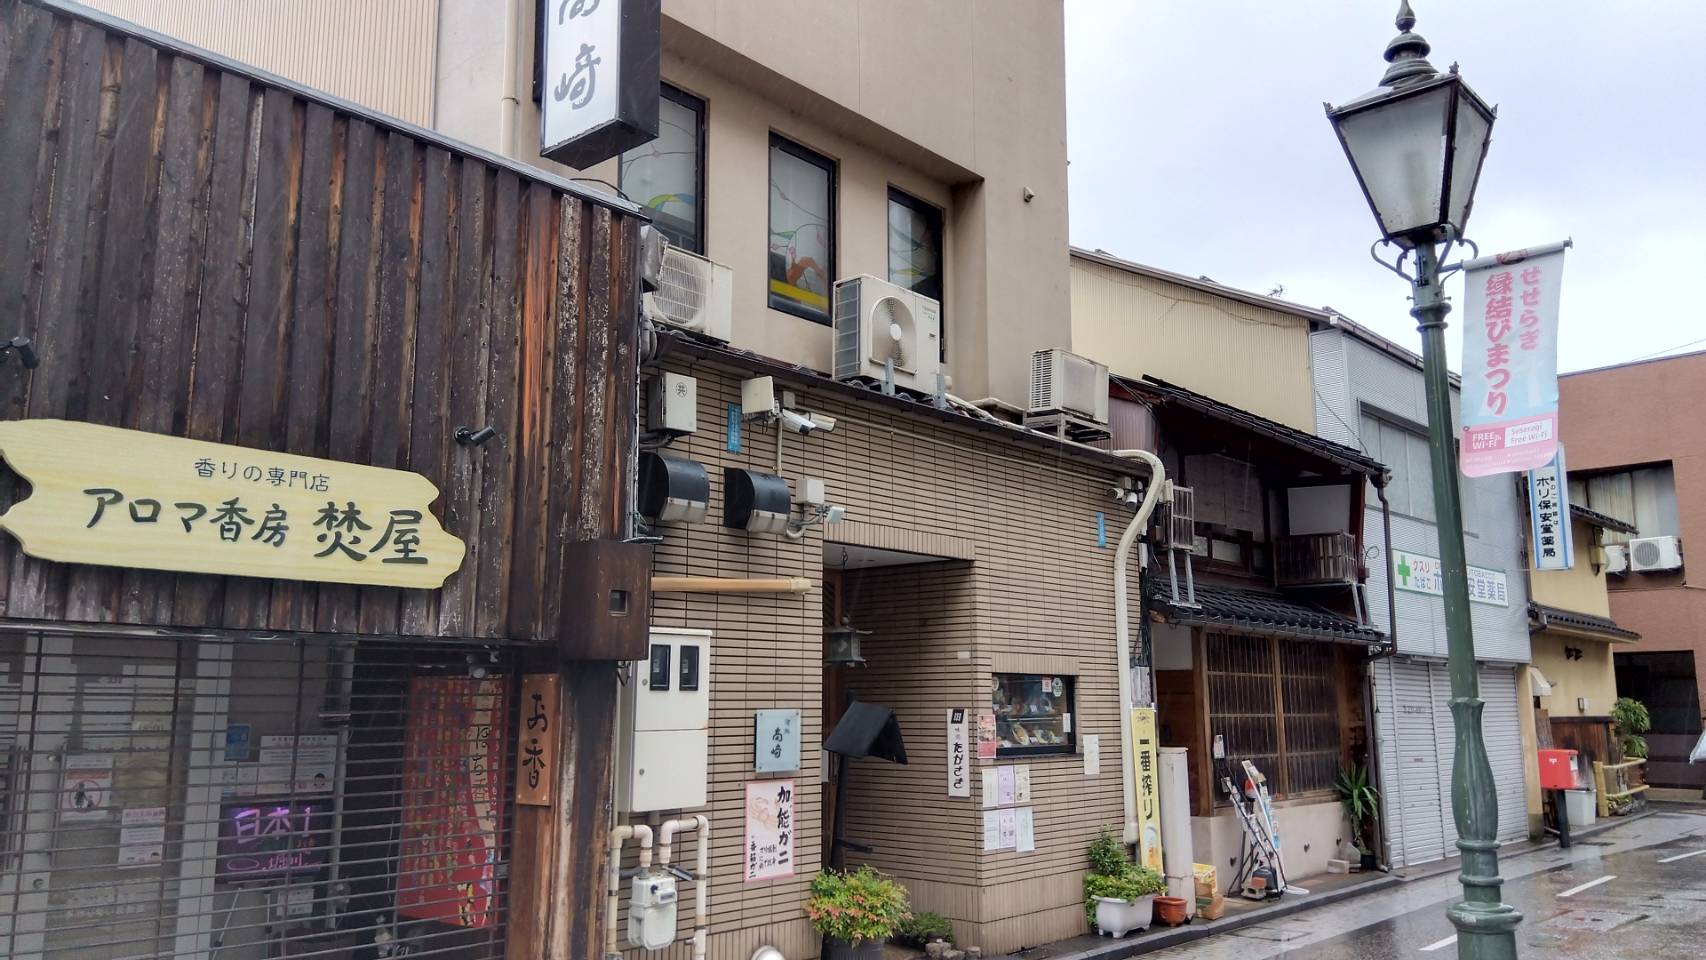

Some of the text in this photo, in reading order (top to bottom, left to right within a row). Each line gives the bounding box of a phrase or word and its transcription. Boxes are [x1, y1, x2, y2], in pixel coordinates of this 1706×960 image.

[1485, 271, 1513, 416] 縁結びまつり
[1519, 266, 1542, 351] せせらぎ
[1472, 431, 1495, 441] FREE
[194, 458, 331, 493] 香りの専門店
[83, 488, 429, 564] アロマ香房 焚屋
[1536, 477, 1556, 558] ホリ保安堂薬局
[1412, 560, 1430, 573] クスリ
[1415, 576, 1432, 590] たばこ
[522, 692, 548, 789] お香
[953, 742, 964, 788] たかさき
[1139, 739, 1153, 820] 一番搾り
[776, 785, 793, 865] 加能ガニ
